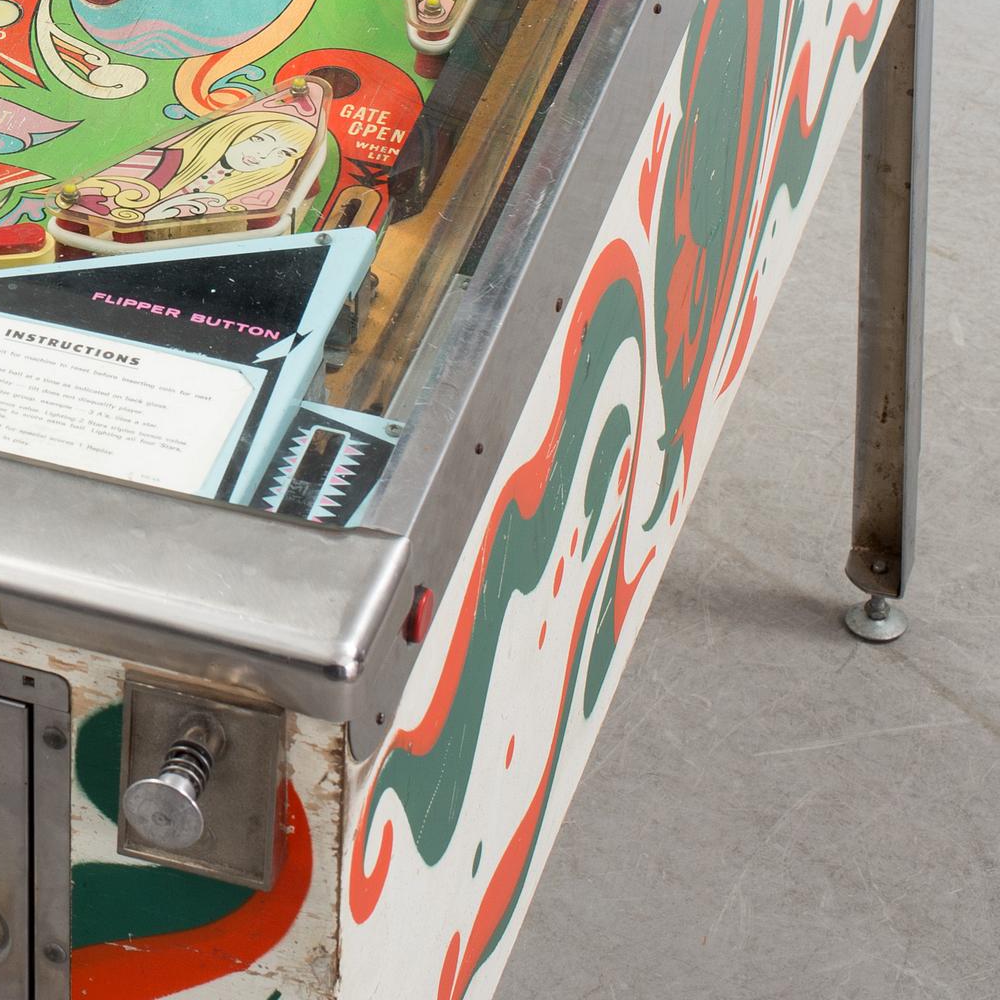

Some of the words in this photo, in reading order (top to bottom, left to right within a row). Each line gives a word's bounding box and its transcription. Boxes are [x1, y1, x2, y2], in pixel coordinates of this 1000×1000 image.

[340, 103, 391, 125] GATE
[348, 121, 406, 143] OPEN
[355, 141, 400, 156] WHEN
[368, 152, 390, 162] LIT
[92, 291, 181, 318] FLIPPER
[190, 313, 281, 340] BUTTON
[4, 329, 141, 366] INSTRUCTIONS
